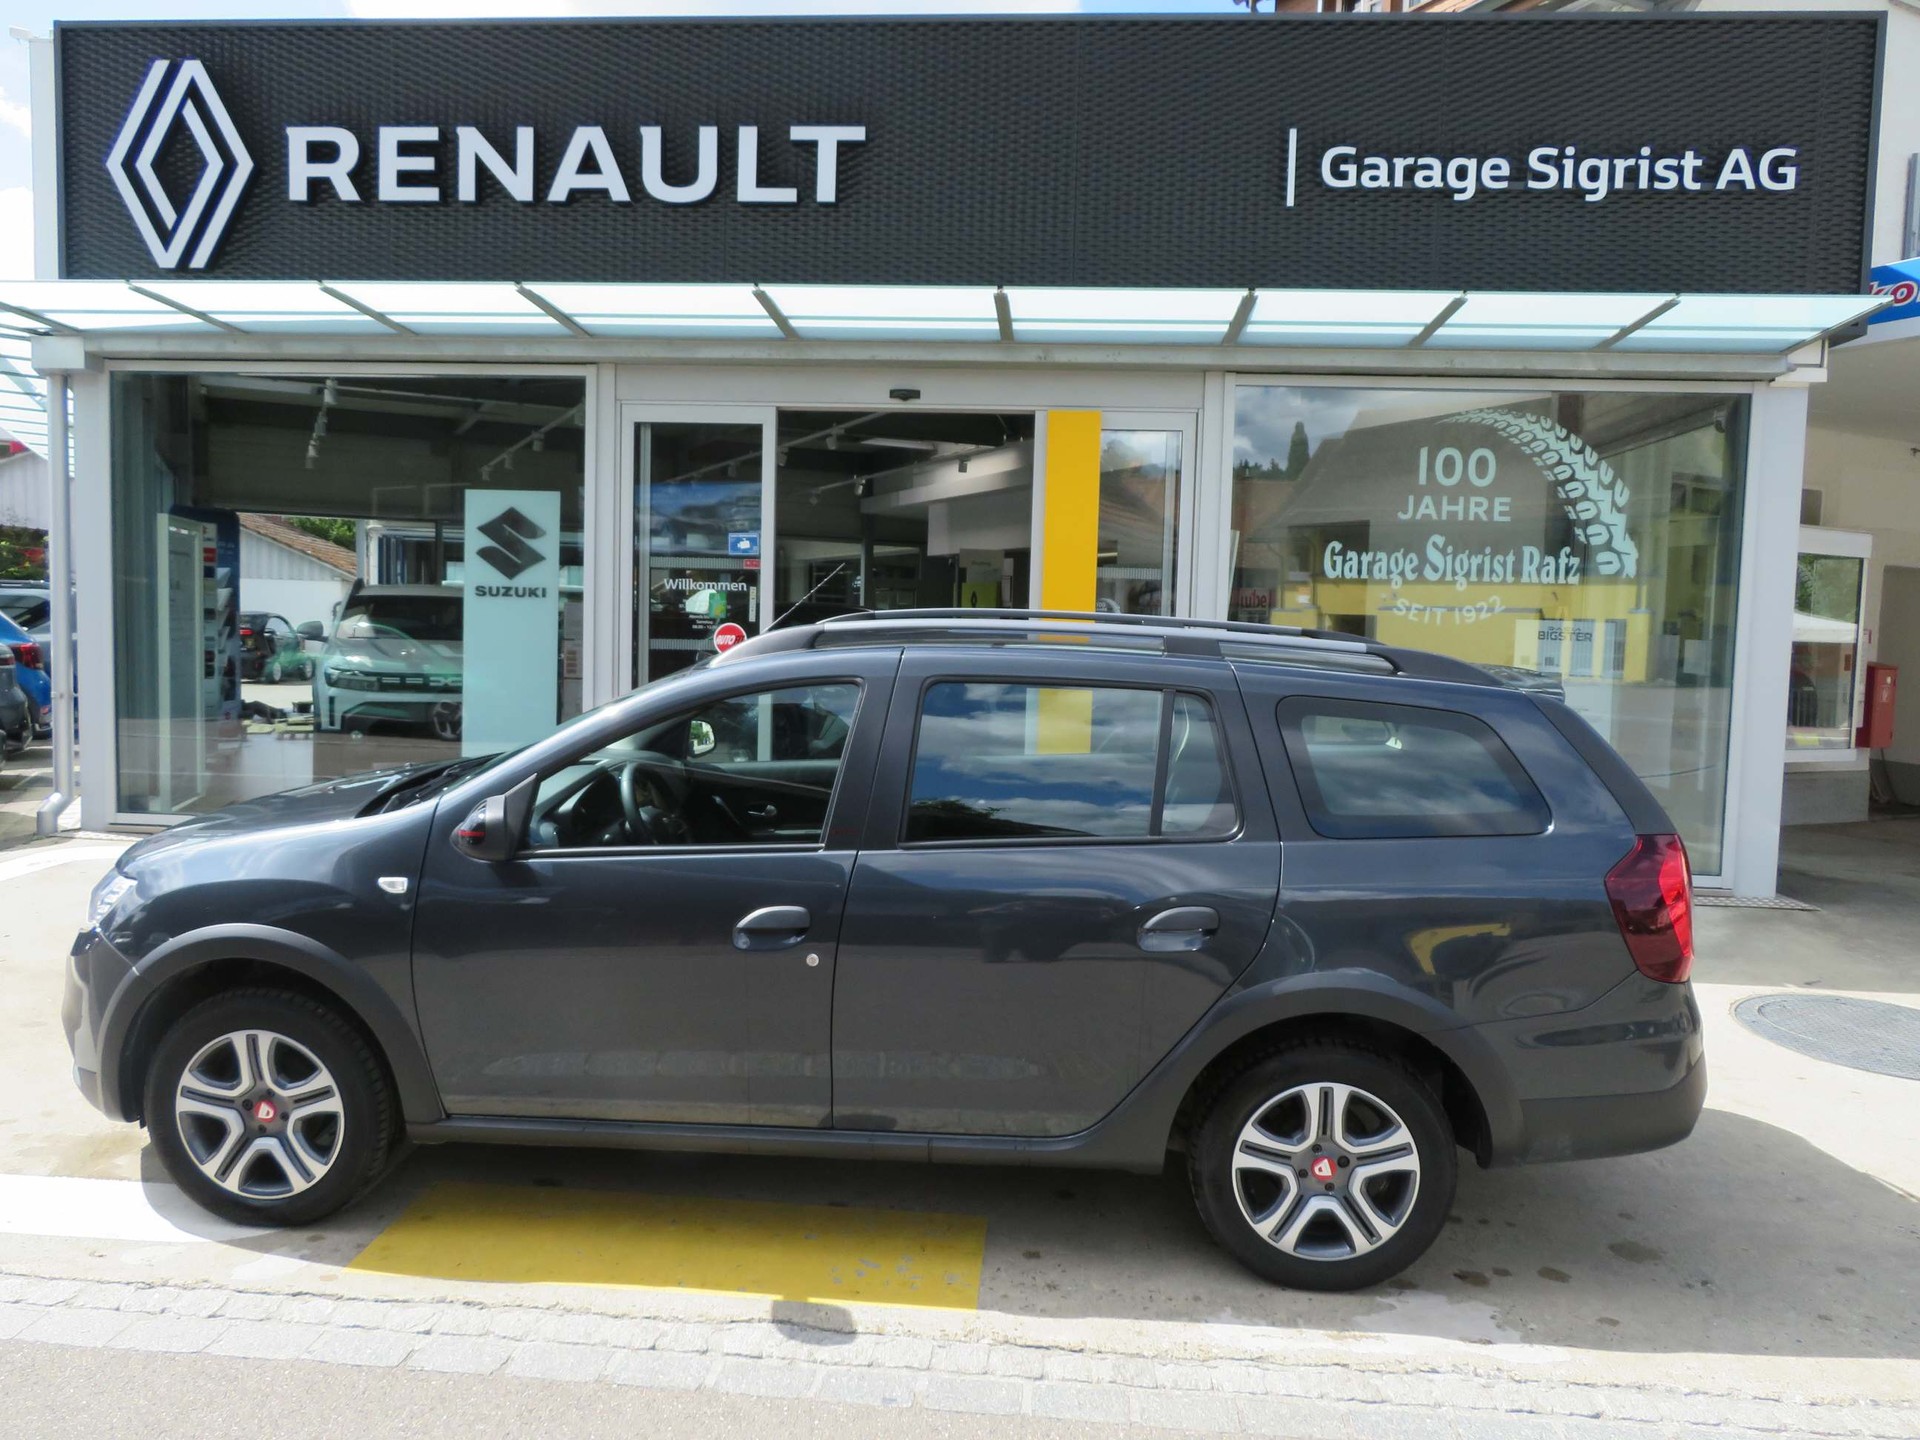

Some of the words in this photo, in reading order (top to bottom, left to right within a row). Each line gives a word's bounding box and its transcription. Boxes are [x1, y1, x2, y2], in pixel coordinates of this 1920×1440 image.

[286, 125, 867, 203] RENAULT
[1320, 146, 1511, 202] Garage
[1527, 146, 1702, 203] Sigrist
[1715, 147, 1799, 192] AG
[1417, 446, 1497, 487] 100
[1397, 495, 1512, 522] JAHRE
[1323, 540, 1420, 589] Garage
[1422, 533, 1516, 592] Sigrist
[1520, 545, 1582, 585] Rafz
[475, 585, 547, 598] SUZUKI
[664, 579, 747, 591] Willkommen
[1392, 598, 1443, 626] SEIT
[1453, 595, 1506, 625] 1922
[1537, 630, 1593, 642] BIGSTER
